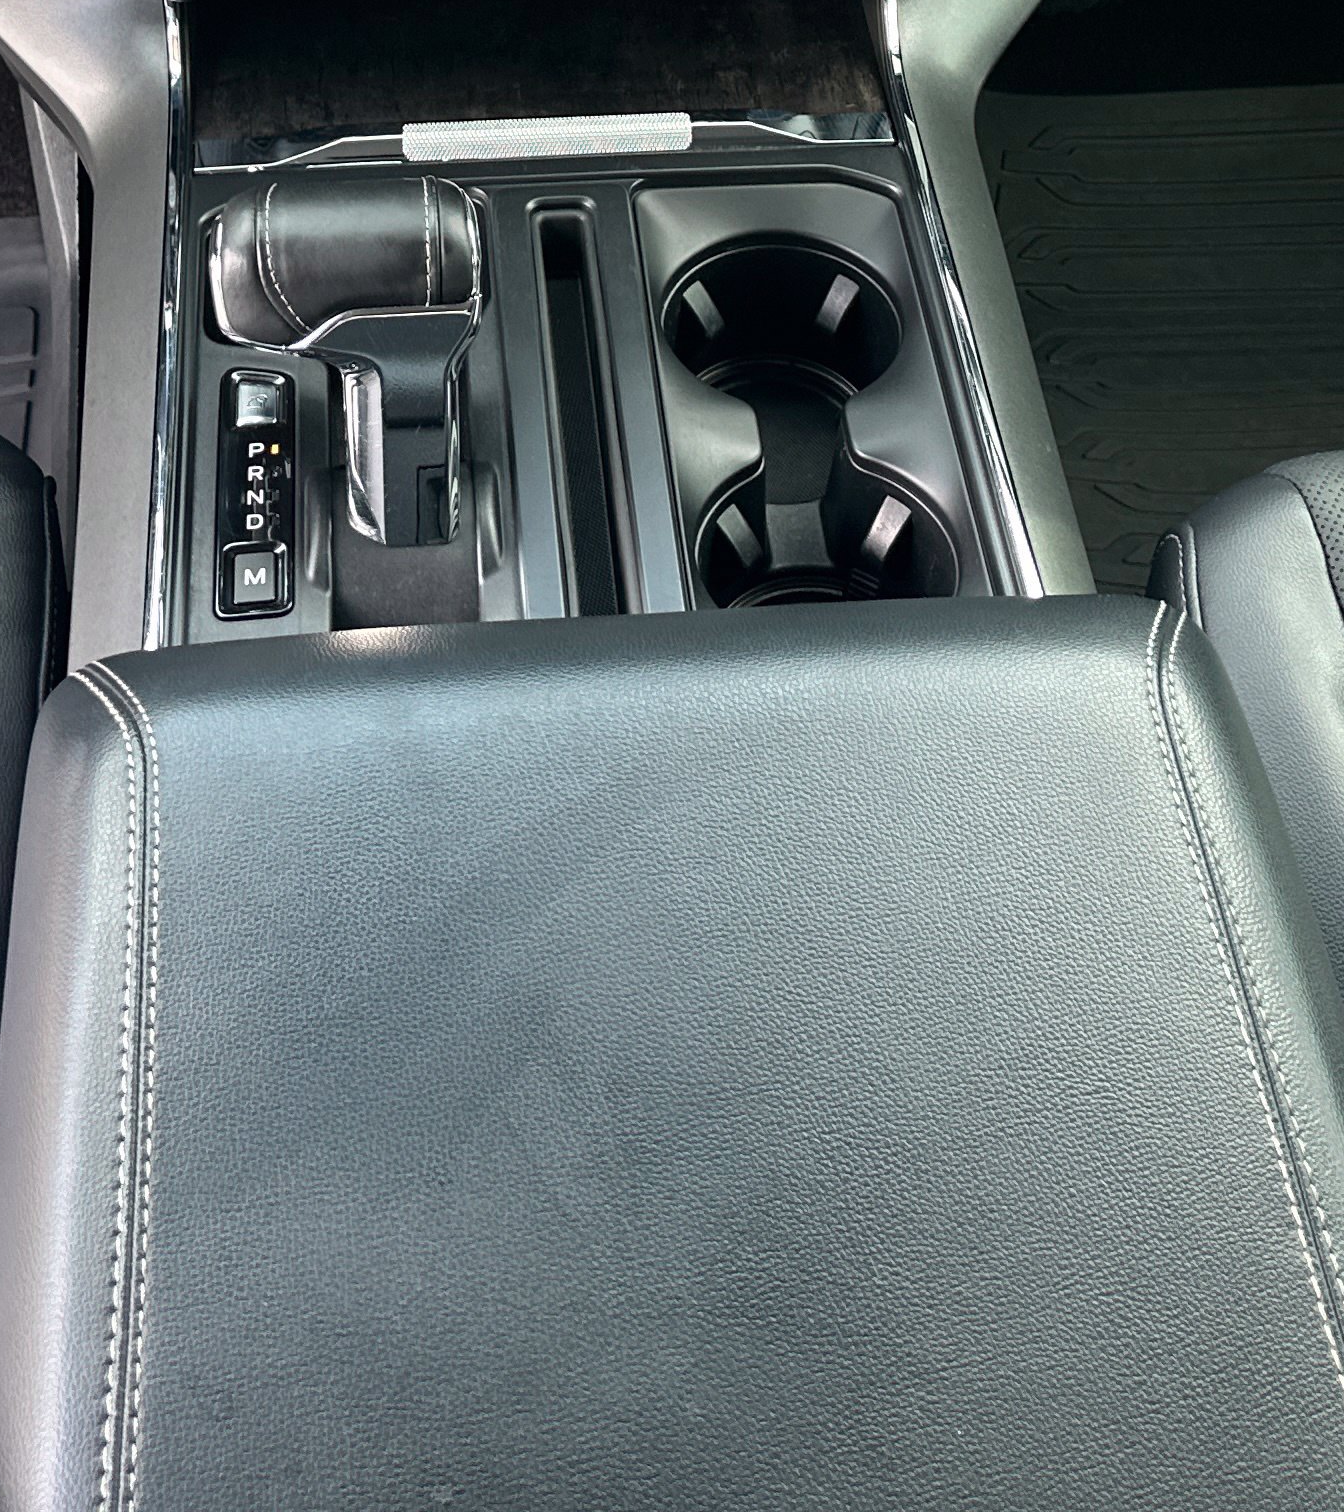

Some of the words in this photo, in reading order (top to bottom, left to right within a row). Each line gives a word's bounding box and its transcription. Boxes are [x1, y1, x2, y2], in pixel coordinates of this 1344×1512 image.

[248, 442, 265, 458] P
[247, 465, 264, 482] R
[246, 489, 264, 506] N
[245, 513, 264, 530] D
[243, 567, 267, 586] M
